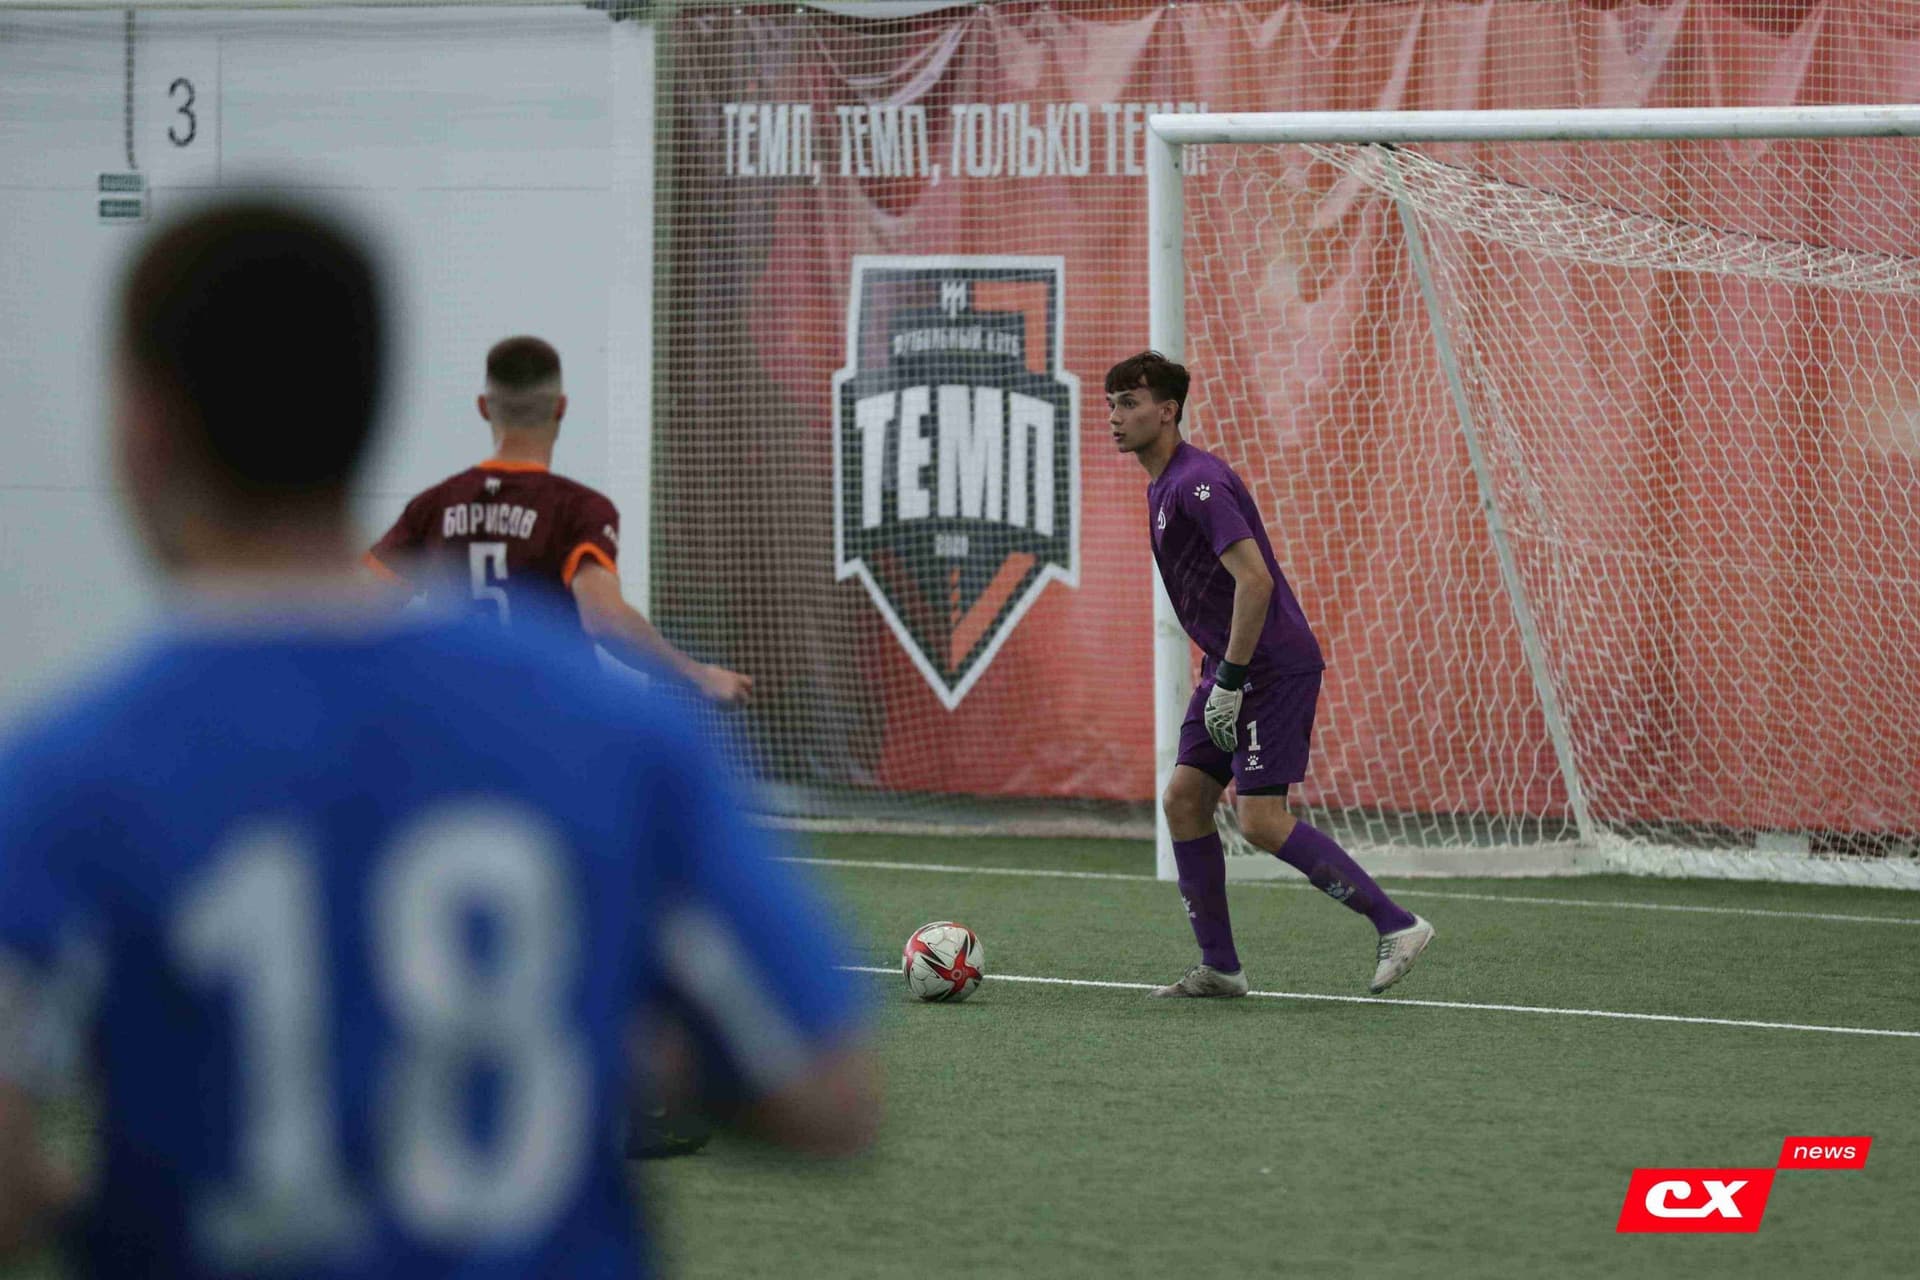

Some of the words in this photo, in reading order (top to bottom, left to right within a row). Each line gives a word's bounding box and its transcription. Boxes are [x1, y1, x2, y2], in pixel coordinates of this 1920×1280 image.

[168, 77, 197, 147] 3
[723, 104, 821, 184] ТЕМП,
[837, 104, 939, 186] ТЕМП,
[951, 103, 1090, 176] ТОЛЬКО
[855, 384, 1055, 537] ТЕМП
[442, 503, 538, 539] БОРИСОВ
[468, 542, 512, 628] 5
[1246, 720, 1261, 752] 1
[168, 800, 590, 1265] 18
